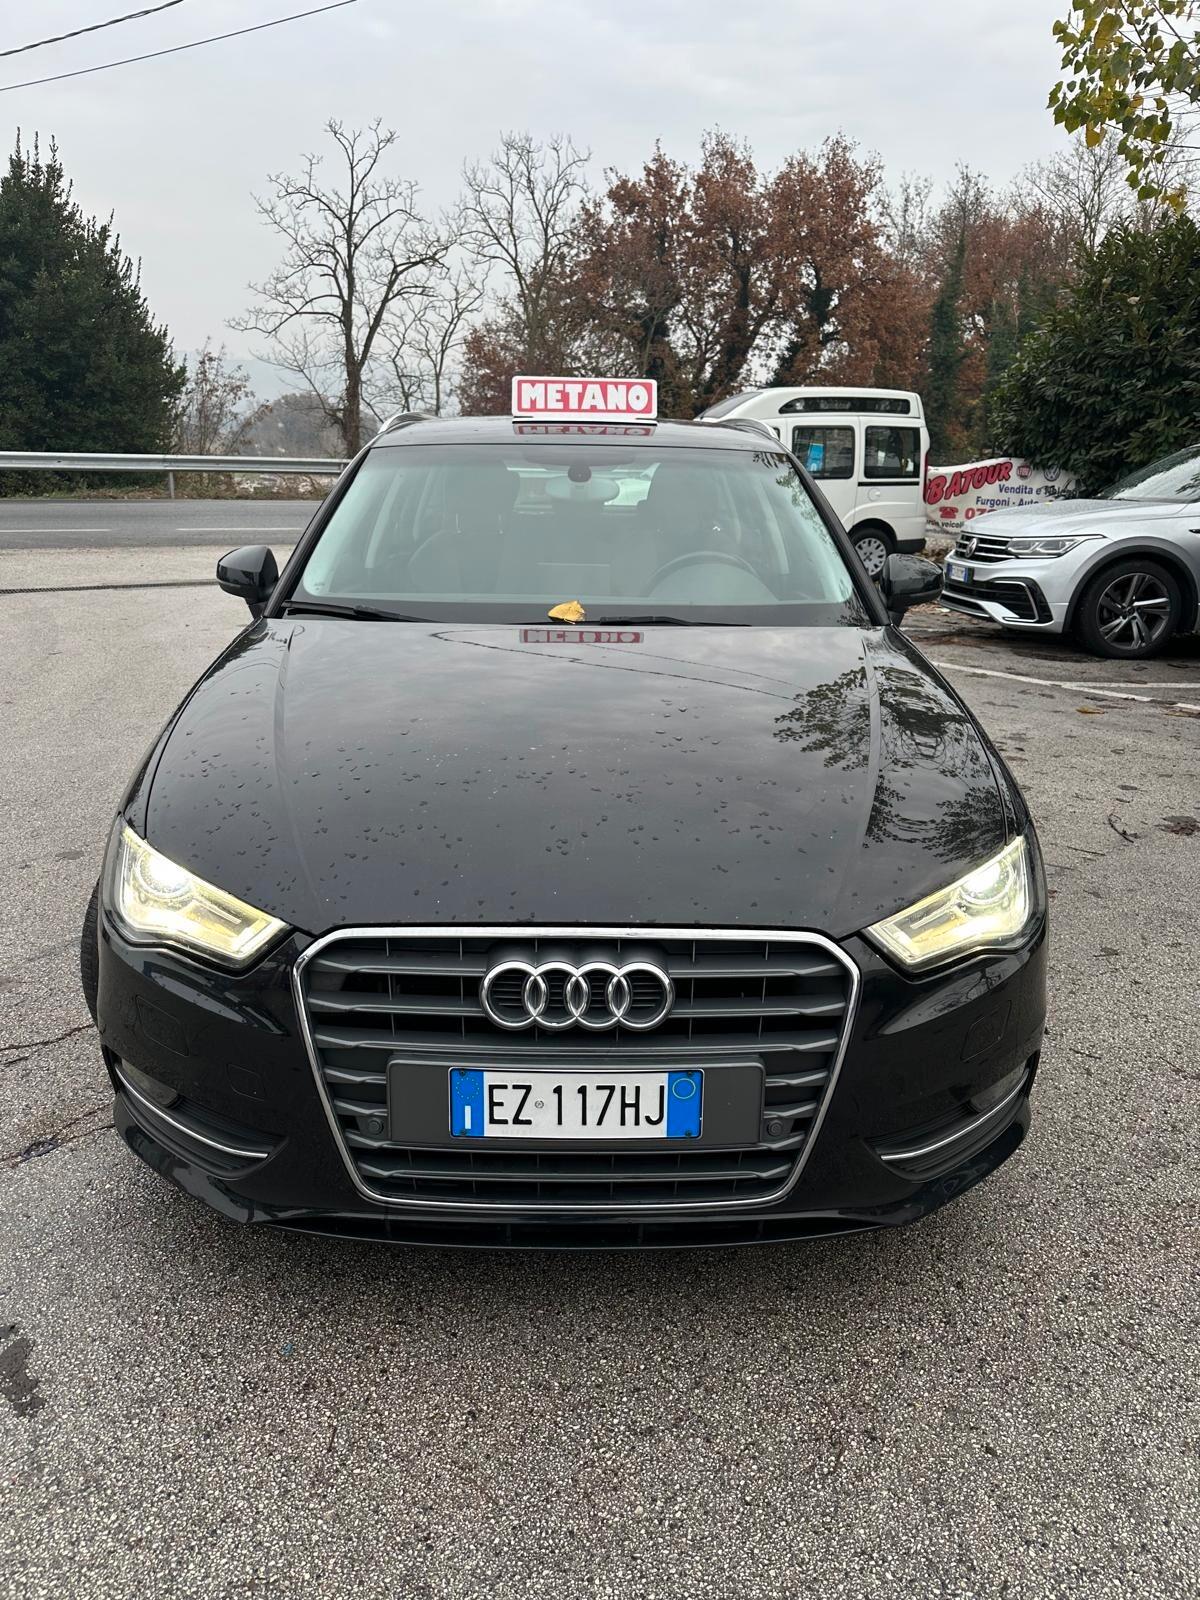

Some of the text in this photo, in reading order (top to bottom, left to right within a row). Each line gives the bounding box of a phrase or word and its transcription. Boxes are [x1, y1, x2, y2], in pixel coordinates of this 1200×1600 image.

[521, 382, 649, 411] METANO
[927, 461, 1013, 505] BATOUR
[998, 484, 1034, 495] Vendita
[975, 496, 1010, 508] Furgoni
[488, 1084, 665, 1126] EZ 117HJ
